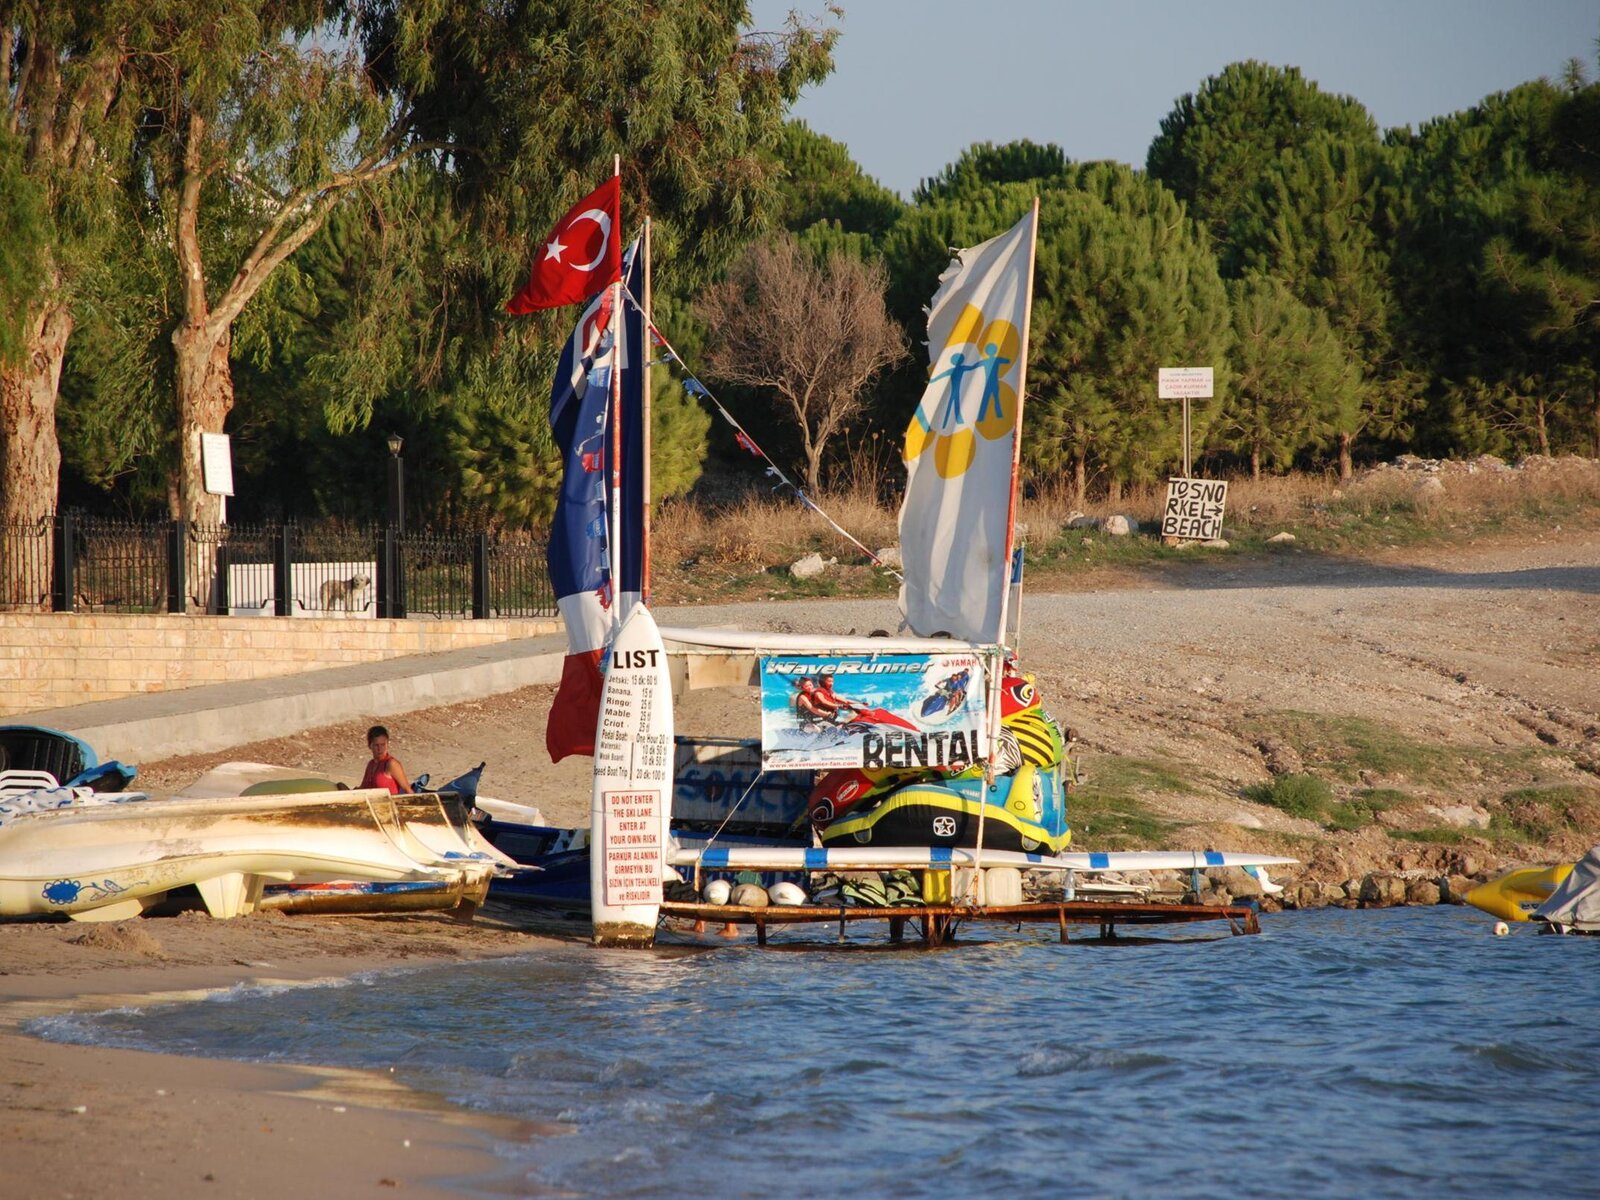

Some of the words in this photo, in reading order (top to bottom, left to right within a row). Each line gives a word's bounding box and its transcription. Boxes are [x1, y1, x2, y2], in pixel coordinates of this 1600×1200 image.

[1166, 498, 1212, 519] RKEL
[1163, 517, 1221, 538] BEACH
[613, 649, 660, 669] LIST
[951, 659, 977, 667] YAMAH
[766, 660, 935, 675] WaveRunner
[605, 708, 631, 718] Mable
[862, 729, 987, 769] RENTAL
[611, 796, 620, 805] DO
[621, 795, 633, 805] NOT
[634, 795, 653, 804] ENTER
[613, 809, 624, 818] THE
[637, 808, 652, 817] LANE
[619, 821, 638, 831] ENTER
[639, 821, 646, 830] AT
[610, 835, 626, 845] YOUR
[627, 835, 641, 844] OWN
[643, 834, 657, 843] RISK
